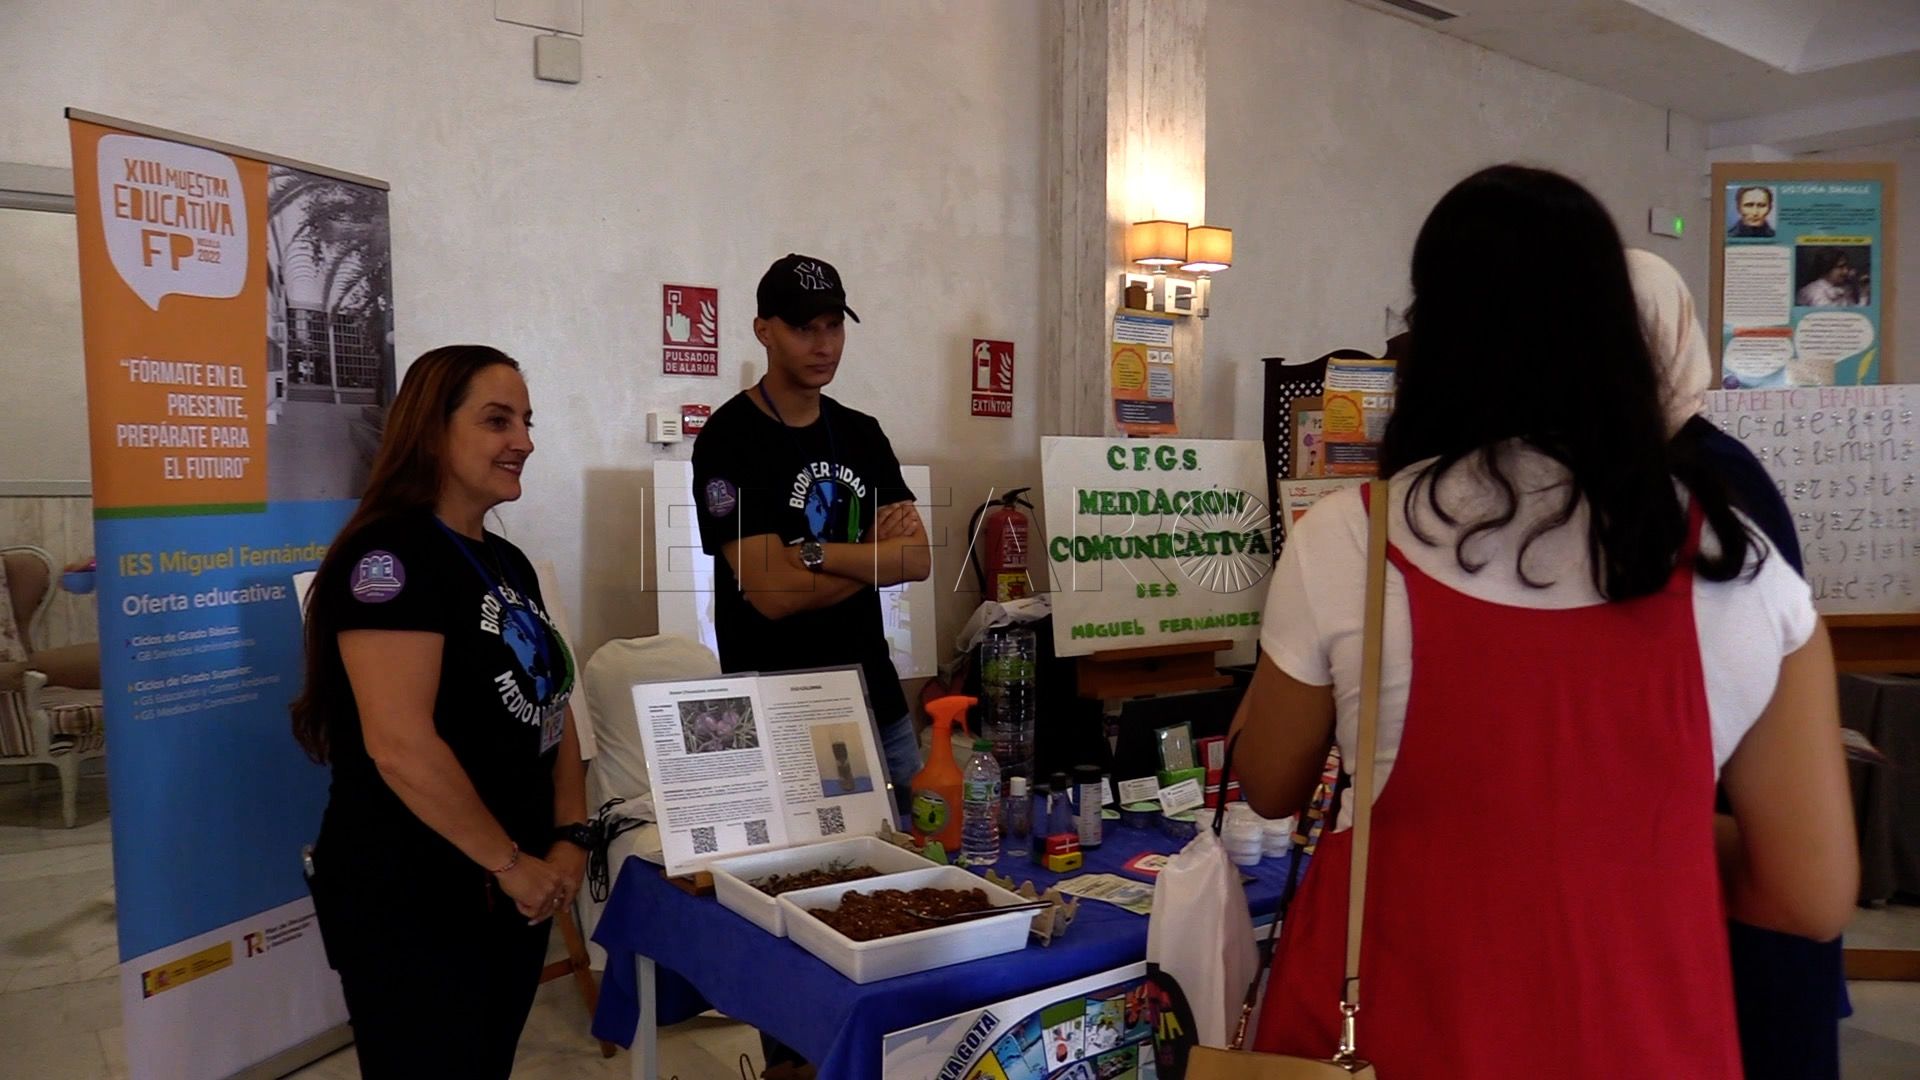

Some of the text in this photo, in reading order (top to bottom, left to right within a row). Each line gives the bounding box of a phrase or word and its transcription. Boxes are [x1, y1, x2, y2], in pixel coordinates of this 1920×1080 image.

[124, 158, 229, 199] XIII MUESTRA
[114, 184, 234, 236] EDUCATIVA
[141, 229, 194, 271] FP
[197, 249, 220, 264] 2022
[665, 351, 716, 363] PULSADOR
[665, 362, 716, 374] DE ALARMA
[206, 364, 226, 387] EN
[229, 366, 248, 388] EL
[116, 421, 250, 449] PREPÁRATE PARA
[164, 456, 183, 480] EL
[1078, 484, 1245, 516] MEDIACIÓN
[1050, 528, 1271, 563] COMUNICATIVA
[119, 543, 329, 577] IES Miguel Fernánde
[122, 584, 286, 617] Oferta educativa:
[132, 635, 162, 646] Ciclos
[163, 634, 176, 642] de
[178, 630, 208, 641] Grado
[1071, 619, 1145, 640] MIGUEL
[135, 680, 165, 692] Ciclos
[166, 678, 179, 687] de
[181, 674, 210, 685] Grado
